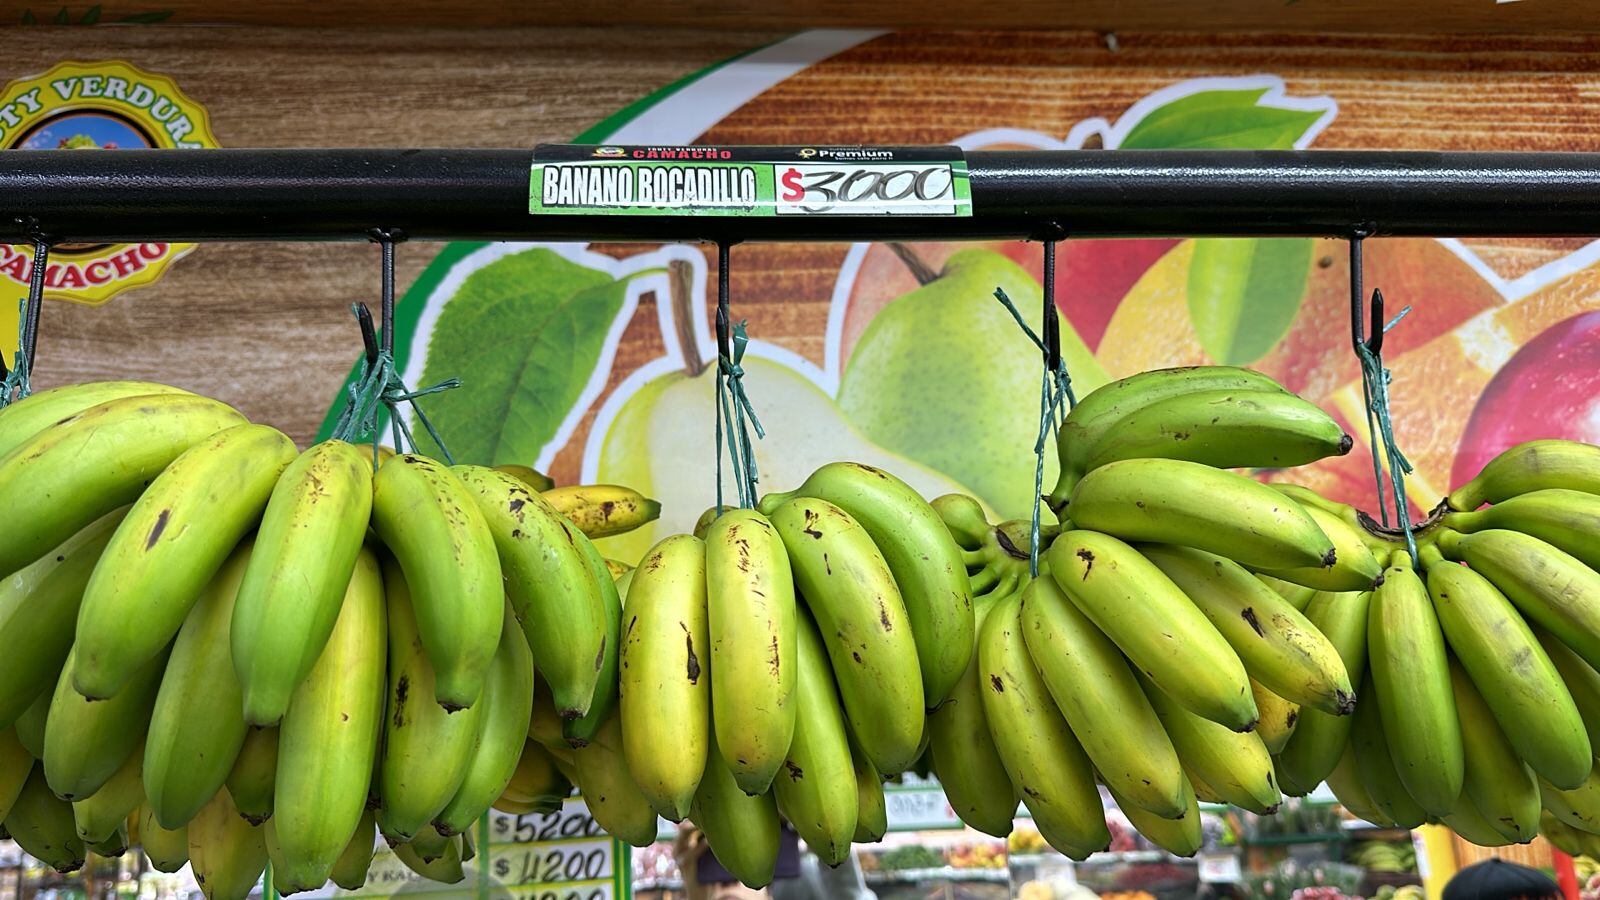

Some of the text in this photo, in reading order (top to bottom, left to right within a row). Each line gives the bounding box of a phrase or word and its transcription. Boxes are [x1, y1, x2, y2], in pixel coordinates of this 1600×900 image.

[0, 87, 43, 141] TY
[632, 150, 732, 159] CAMACHO
[819, 150, 893, 158] Premium
[543, 166, 633, 207] BANANO
[636, 166, 757, 208] BOCADILLO
